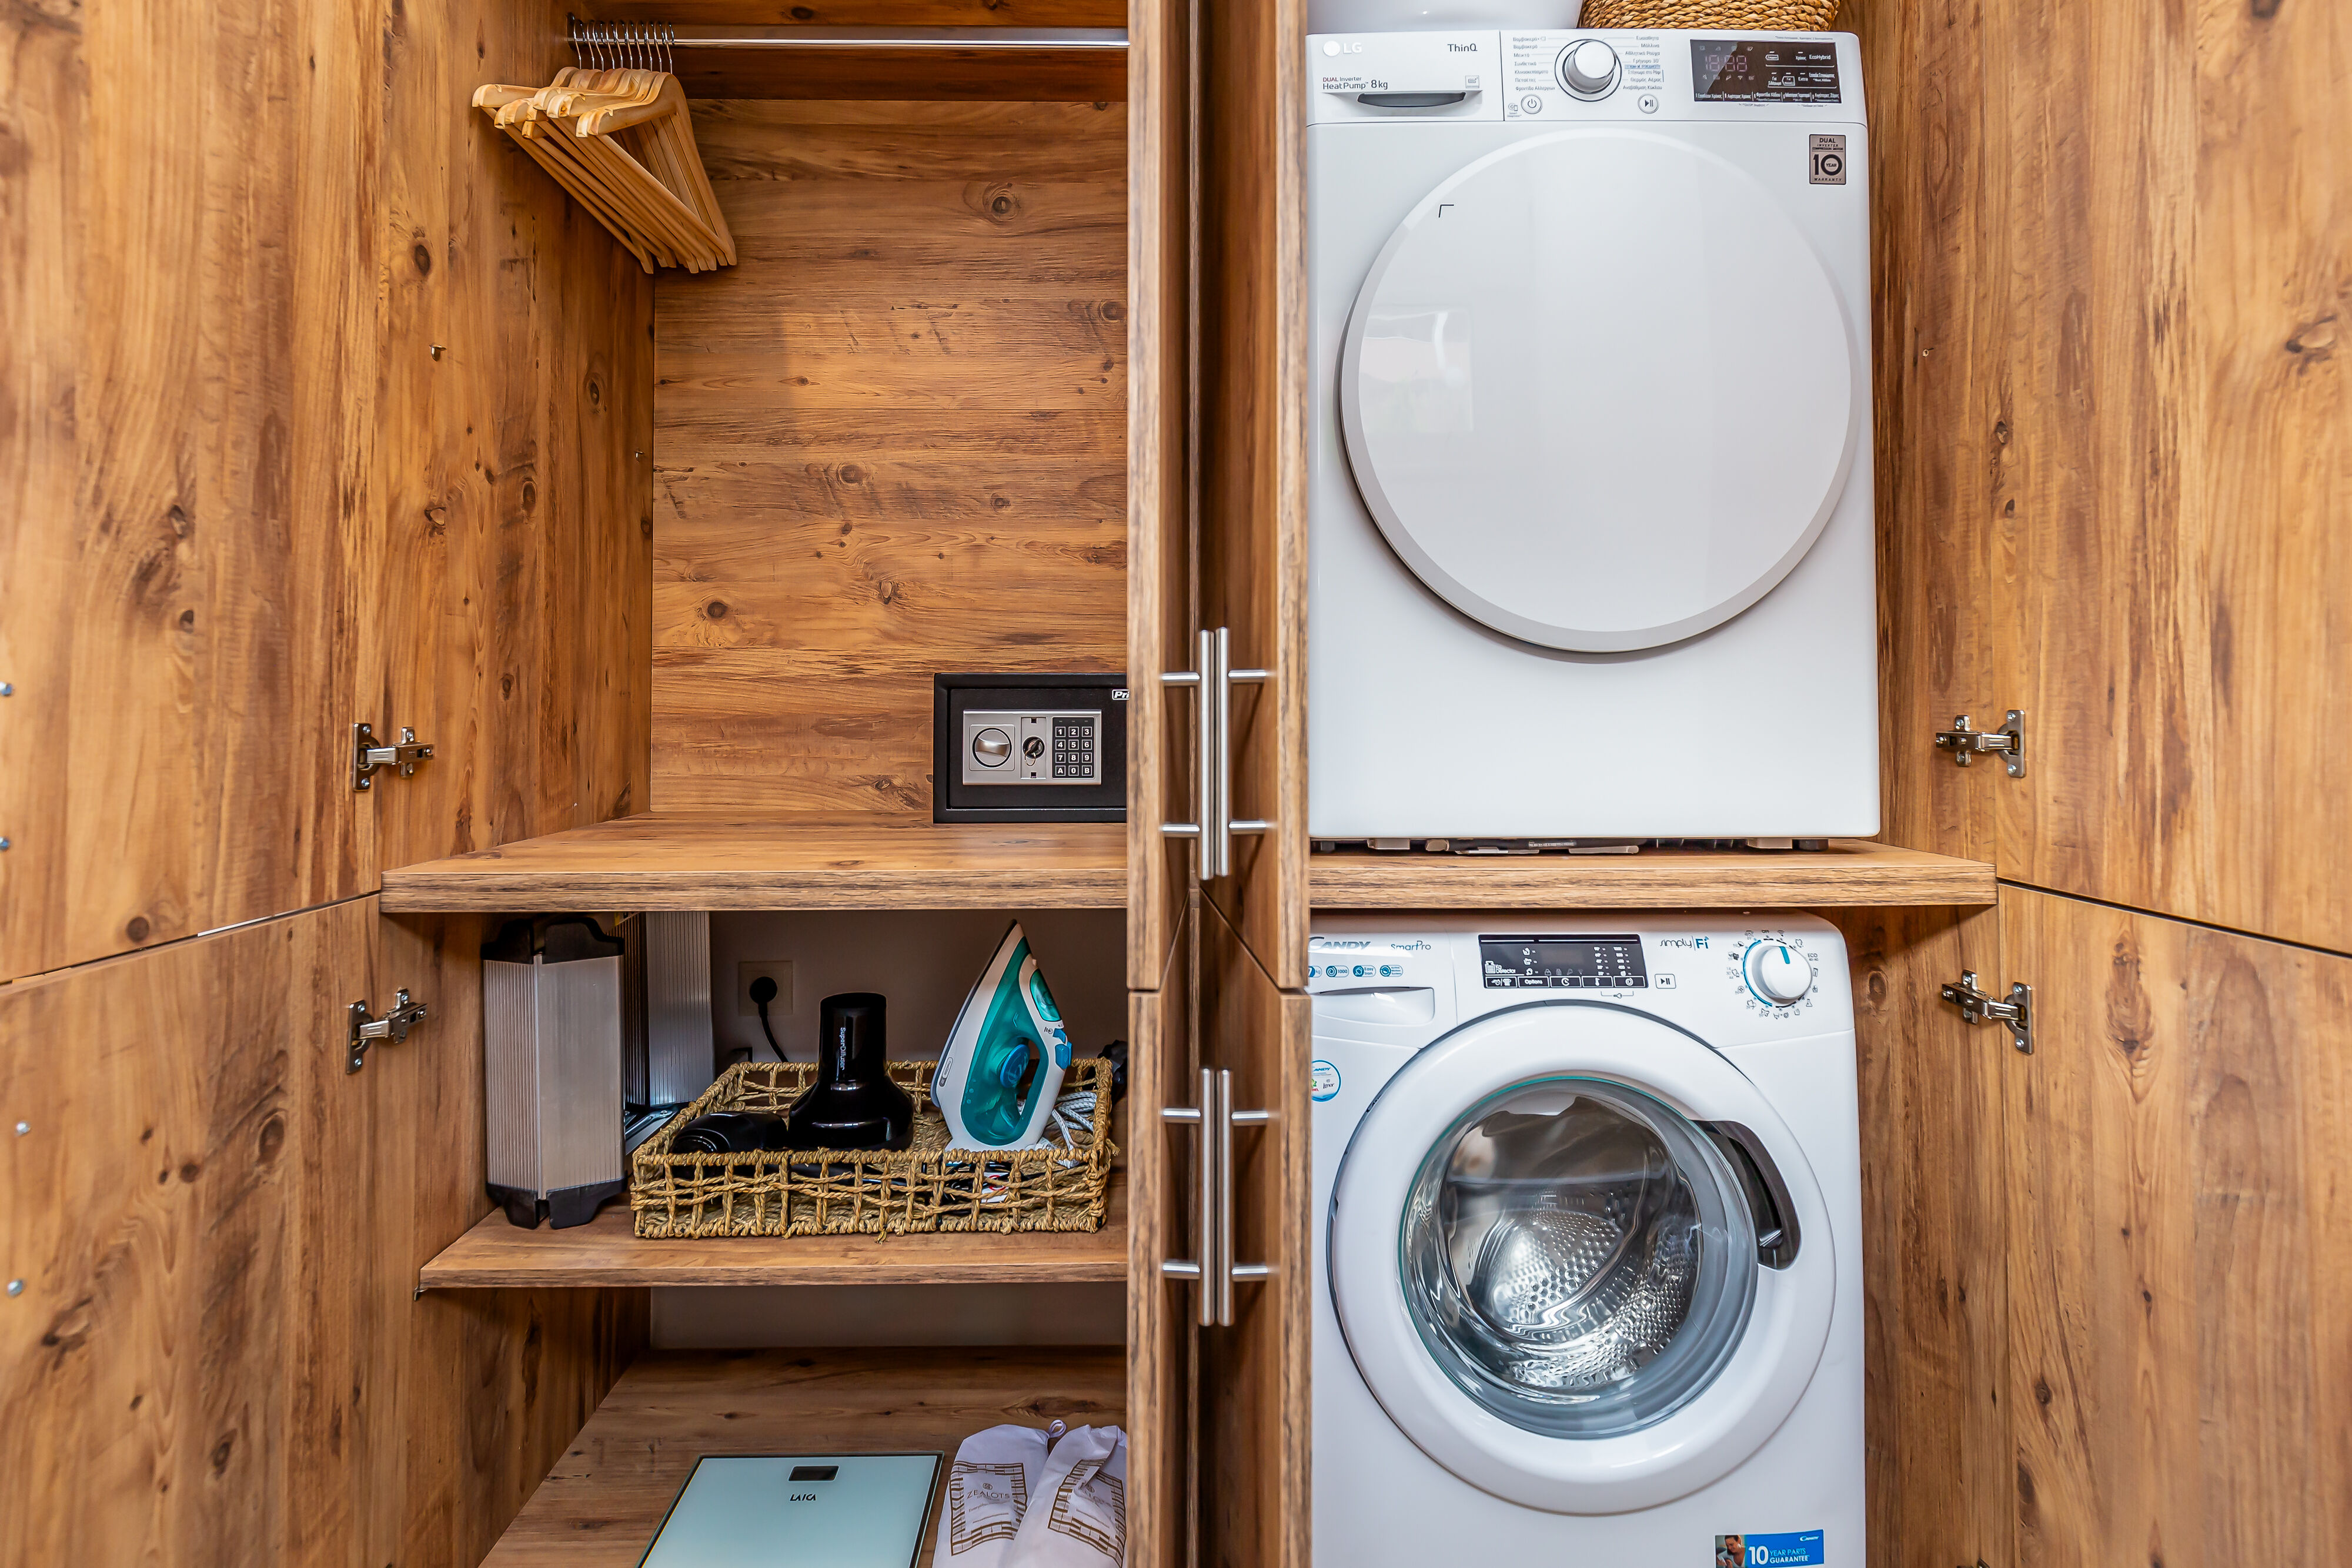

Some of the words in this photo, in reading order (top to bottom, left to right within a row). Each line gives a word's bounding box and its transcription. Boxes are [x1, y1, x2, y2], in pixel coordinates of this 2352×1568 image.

[1343, 42, 1362, 54] LG
[1447, 43, 1478, 52] ThinQ
[1813, 154, 1843, 176] 10
[1391, 941, 1431, 951] SmartPro
[967, 1489, 1010, 1499] ZEALOTS
[1748, 1545, 1769, 1564] 10
[1788, 1547, 1806, 1556] PARTS
